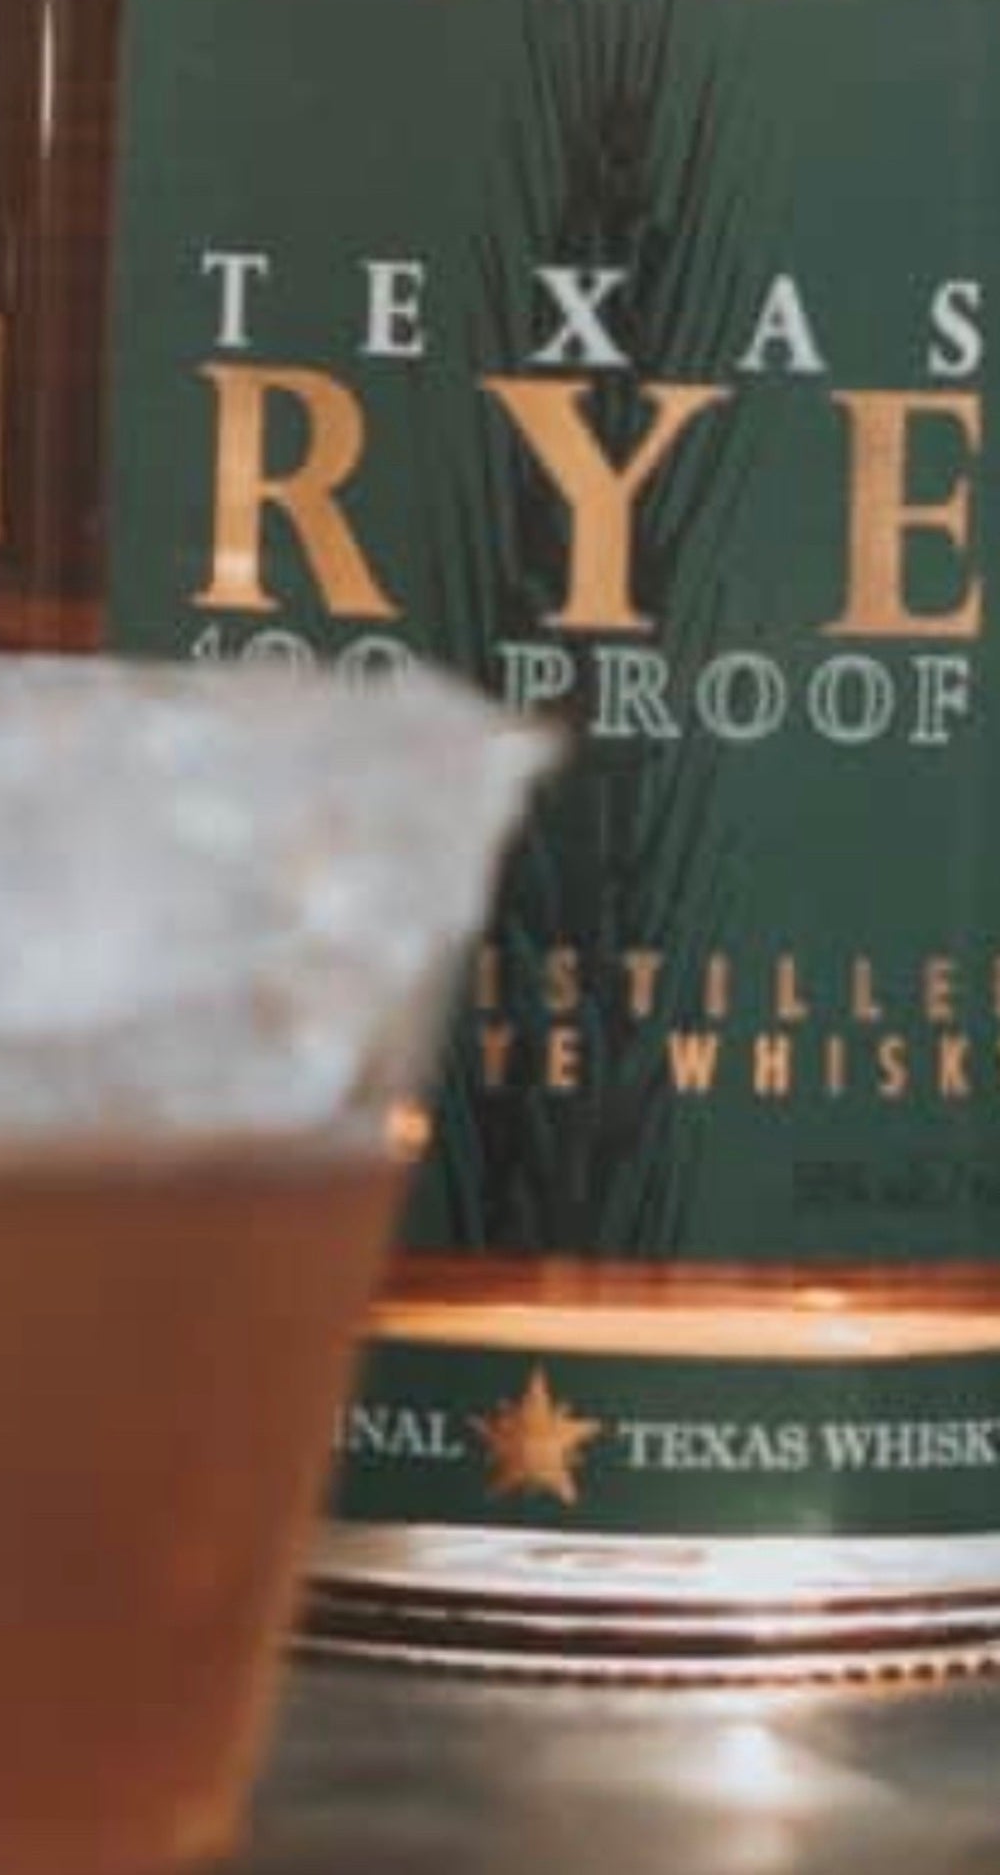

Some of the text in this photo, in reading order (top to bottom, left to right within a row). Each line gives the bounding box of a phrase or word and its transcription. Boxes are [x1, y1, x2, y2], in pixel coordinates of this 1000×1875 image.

[203, 250, 984, 374] TEXAS
[192, 364, 984, 638] RYE
[500, 640, 971, 744] PROOF
[477, 948, 1000, 1019] ISTILLE
[480, 1027, 1000, 1096] YE WHISK
[333, 1404, 1000, 1472] INAL TEXAS WHISK
